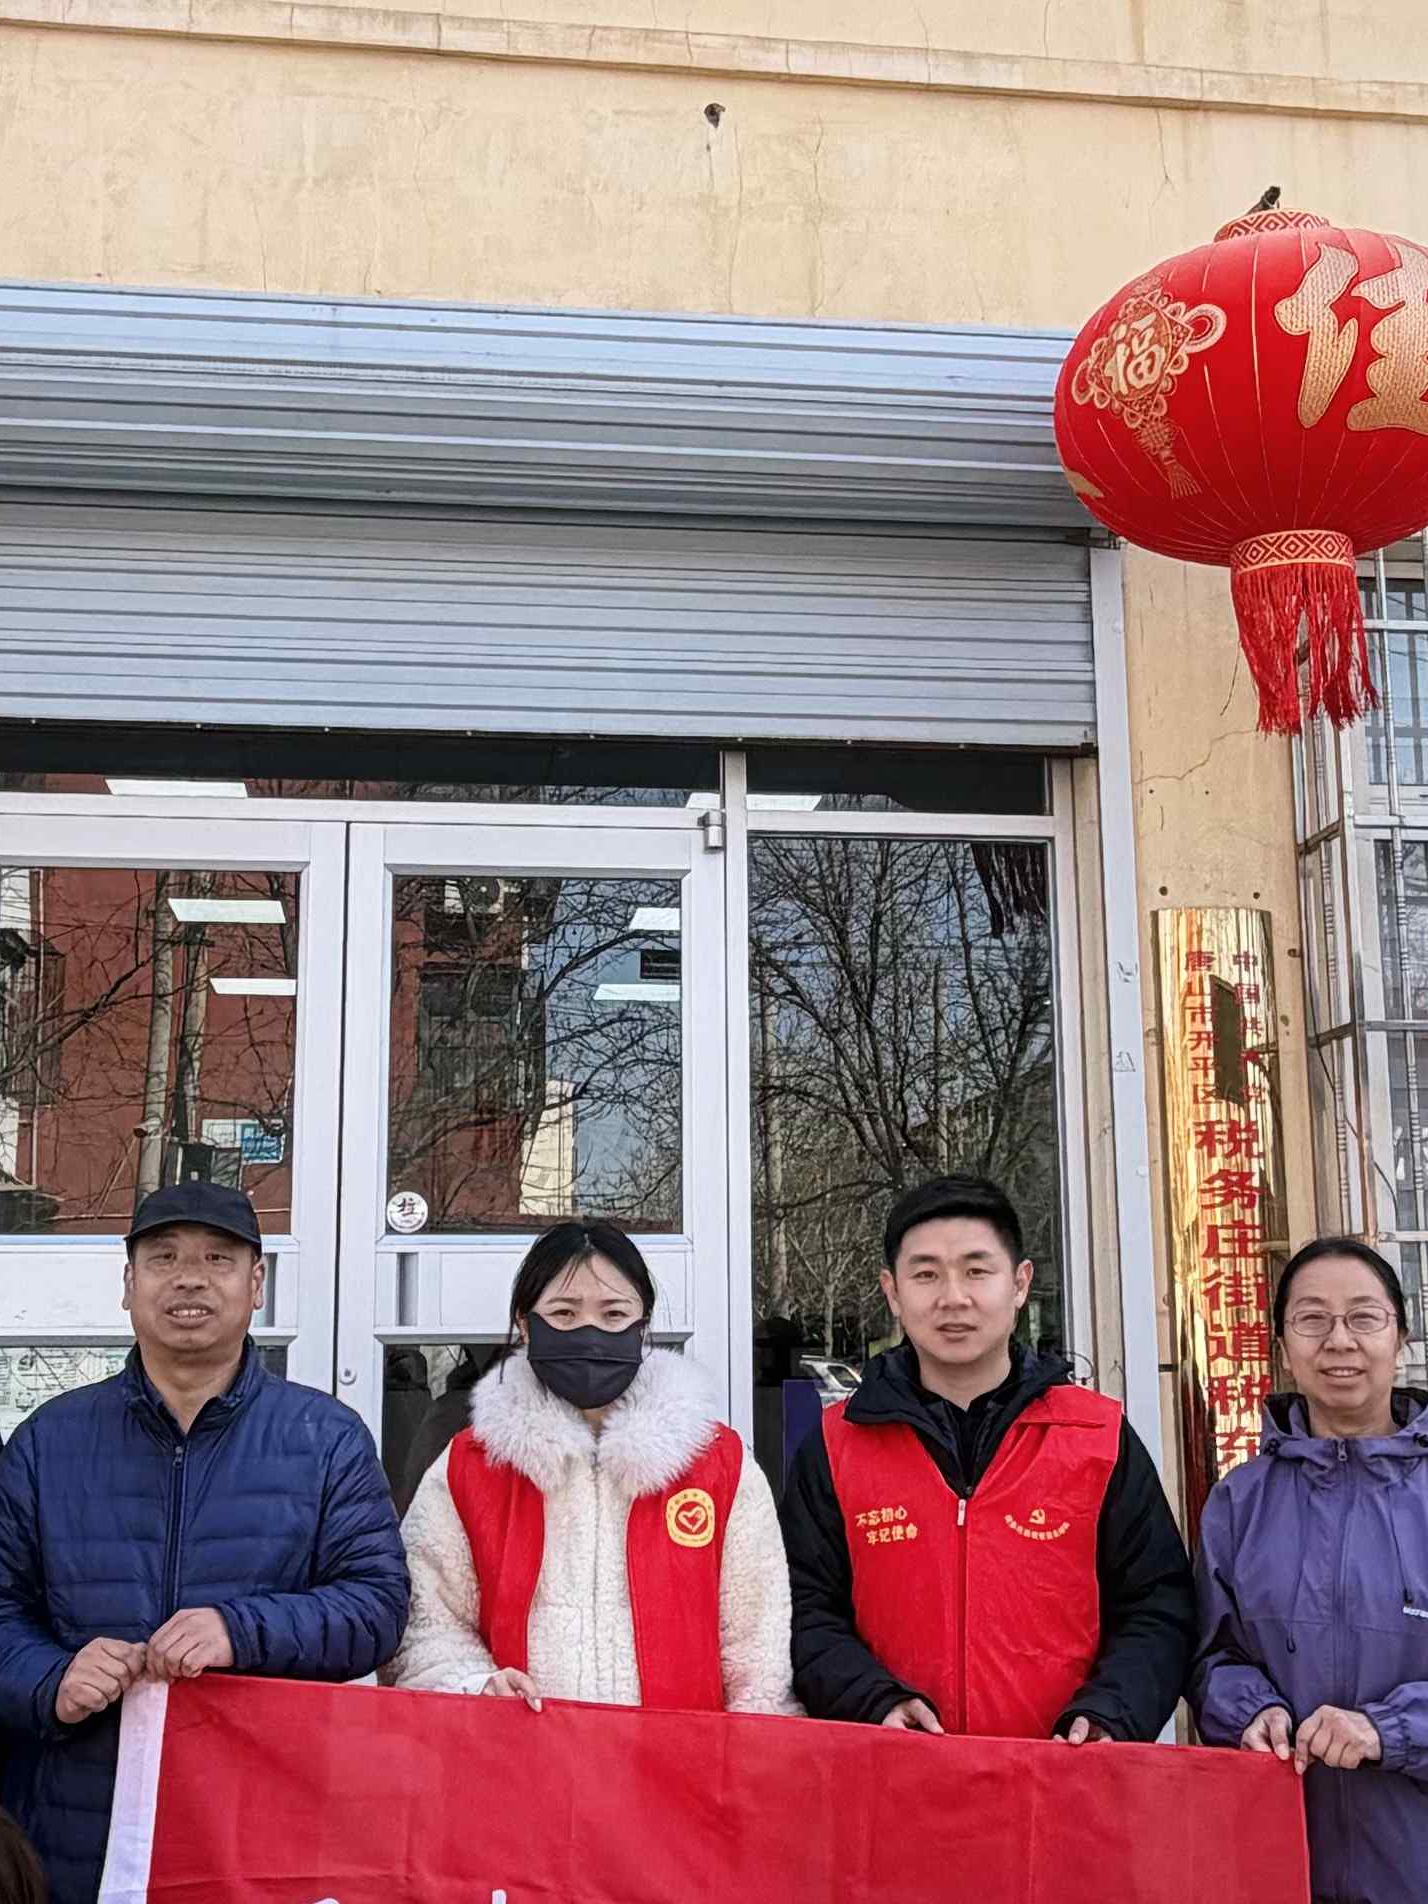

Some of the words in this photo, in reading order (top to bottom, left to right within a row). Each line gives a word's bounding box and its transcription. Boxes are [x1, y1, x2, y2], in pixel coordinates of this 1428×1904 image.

[1103, 311, 1166, 395] 福
[1183, 949, 1224, 1105] 唐山市开平区
[855, 1504, 908, 1528] 不忘初心
[866, 1522, 918, 1546] 牢记使命
